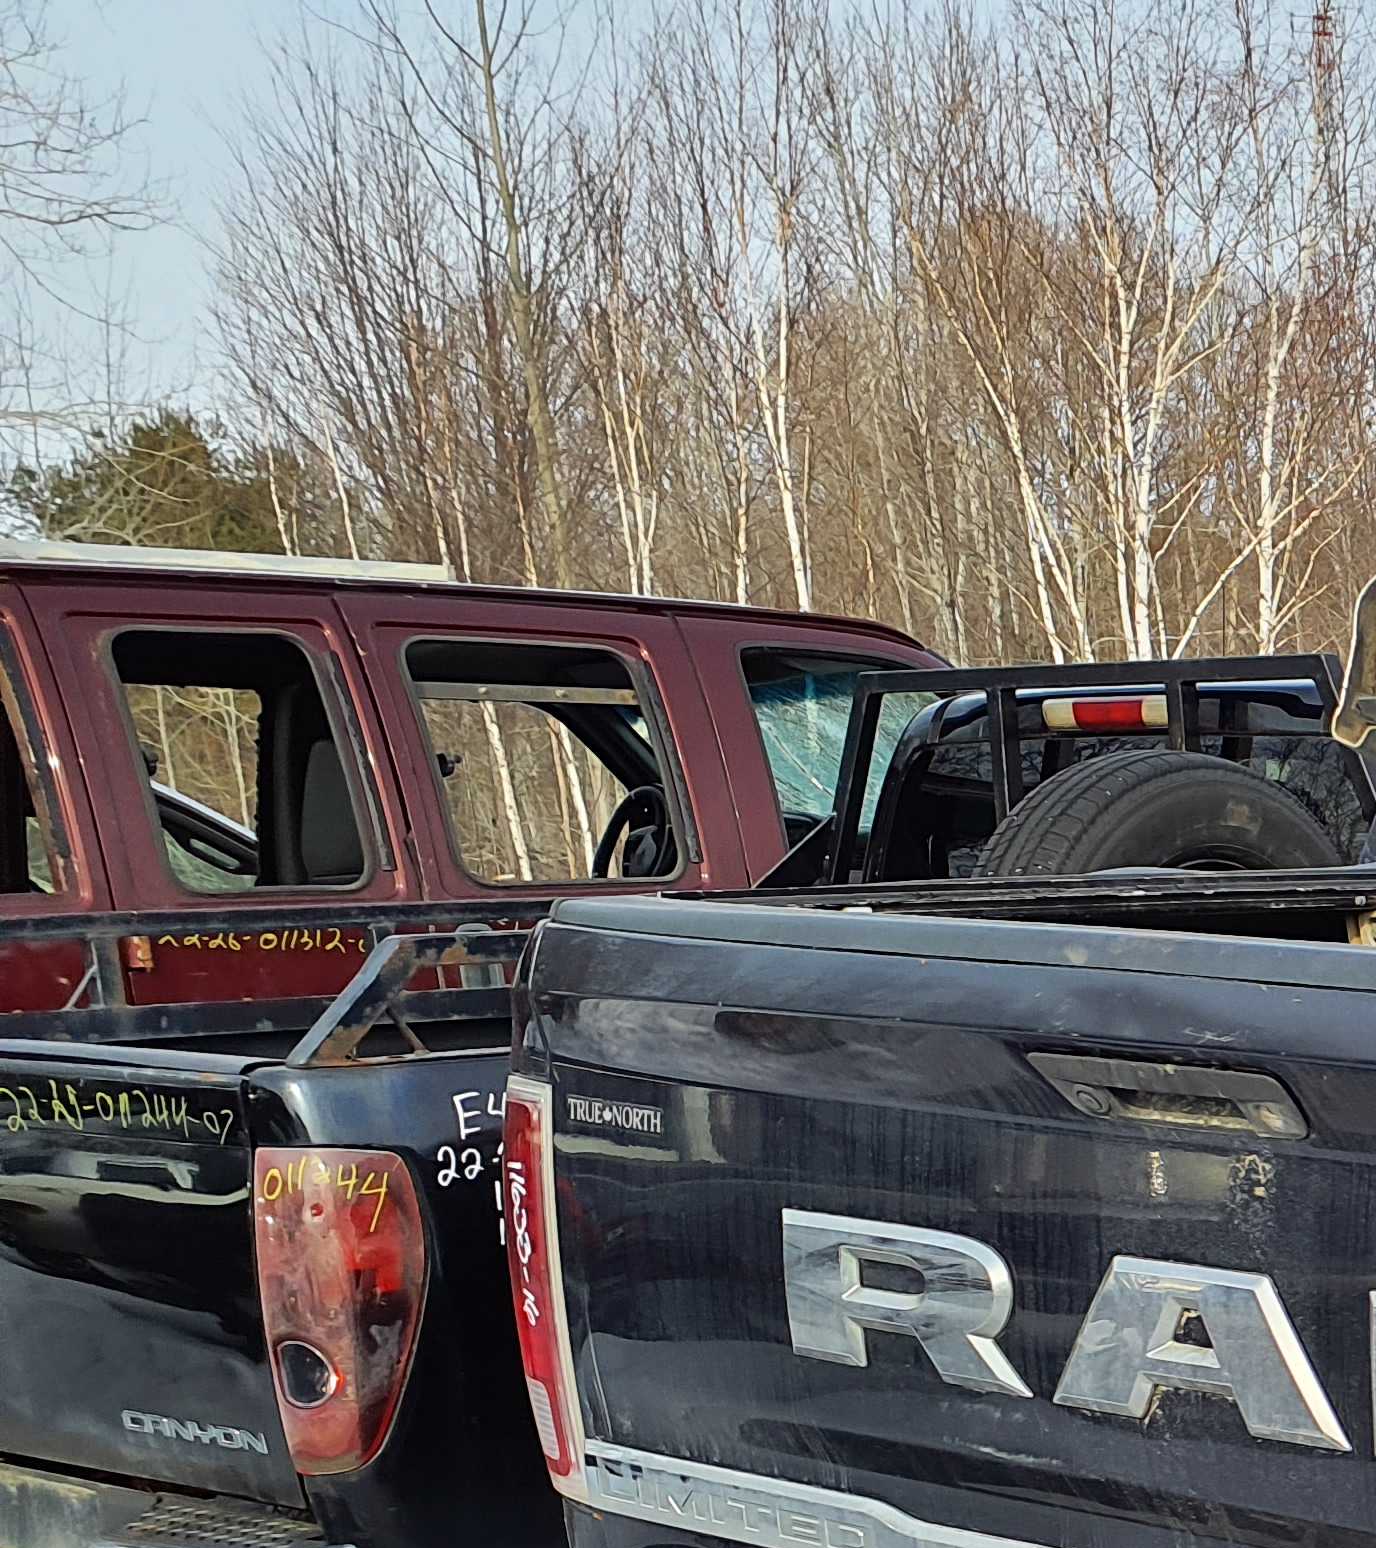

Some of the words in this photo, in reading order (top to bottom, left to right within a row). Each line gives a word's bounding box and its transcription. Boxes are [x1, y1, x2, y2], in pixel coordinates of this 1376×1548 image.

[566, 1098, 603, 1124] TRUE
[612, 1105, 661, 1133] NORTH
[120, 1409, 269, 1455] CANYON
